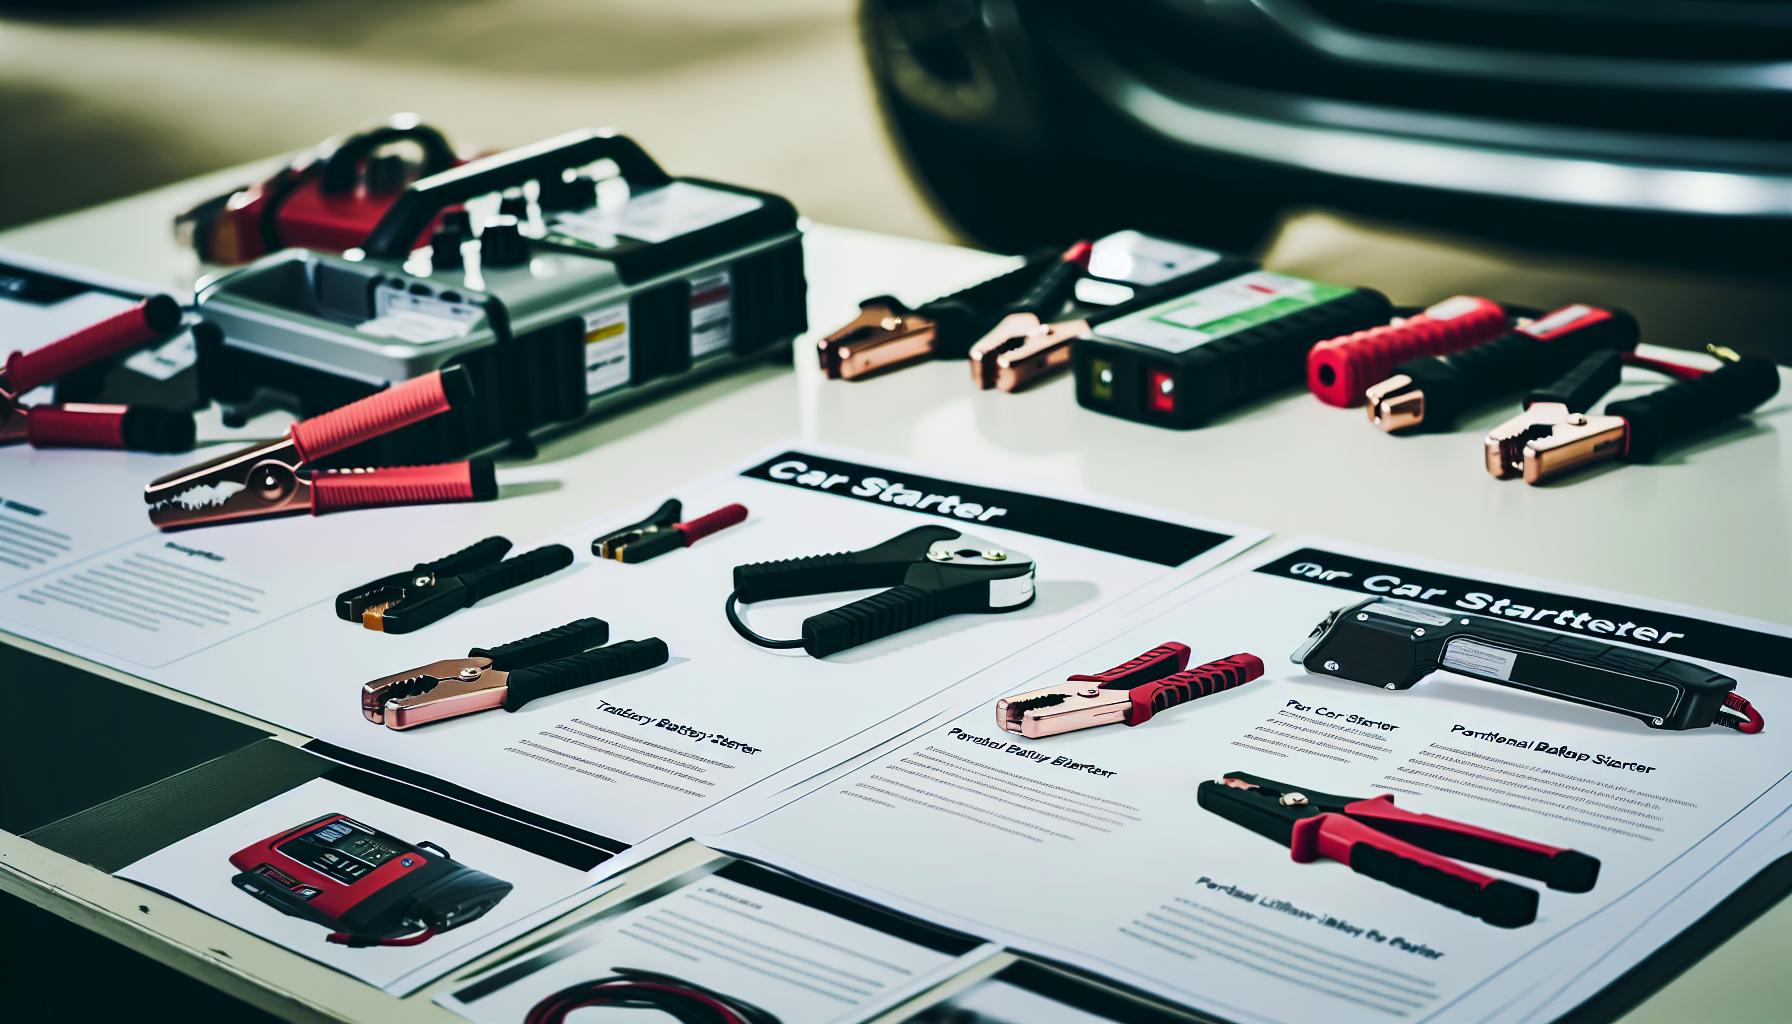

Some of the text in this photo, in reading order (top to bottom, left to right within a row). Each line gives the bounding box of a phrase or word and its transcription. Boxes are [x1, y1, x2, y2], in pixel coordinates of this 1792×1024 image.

[768, 460, 1007, 521] Car Starter
[1363, 575, 1447, 600] Car
